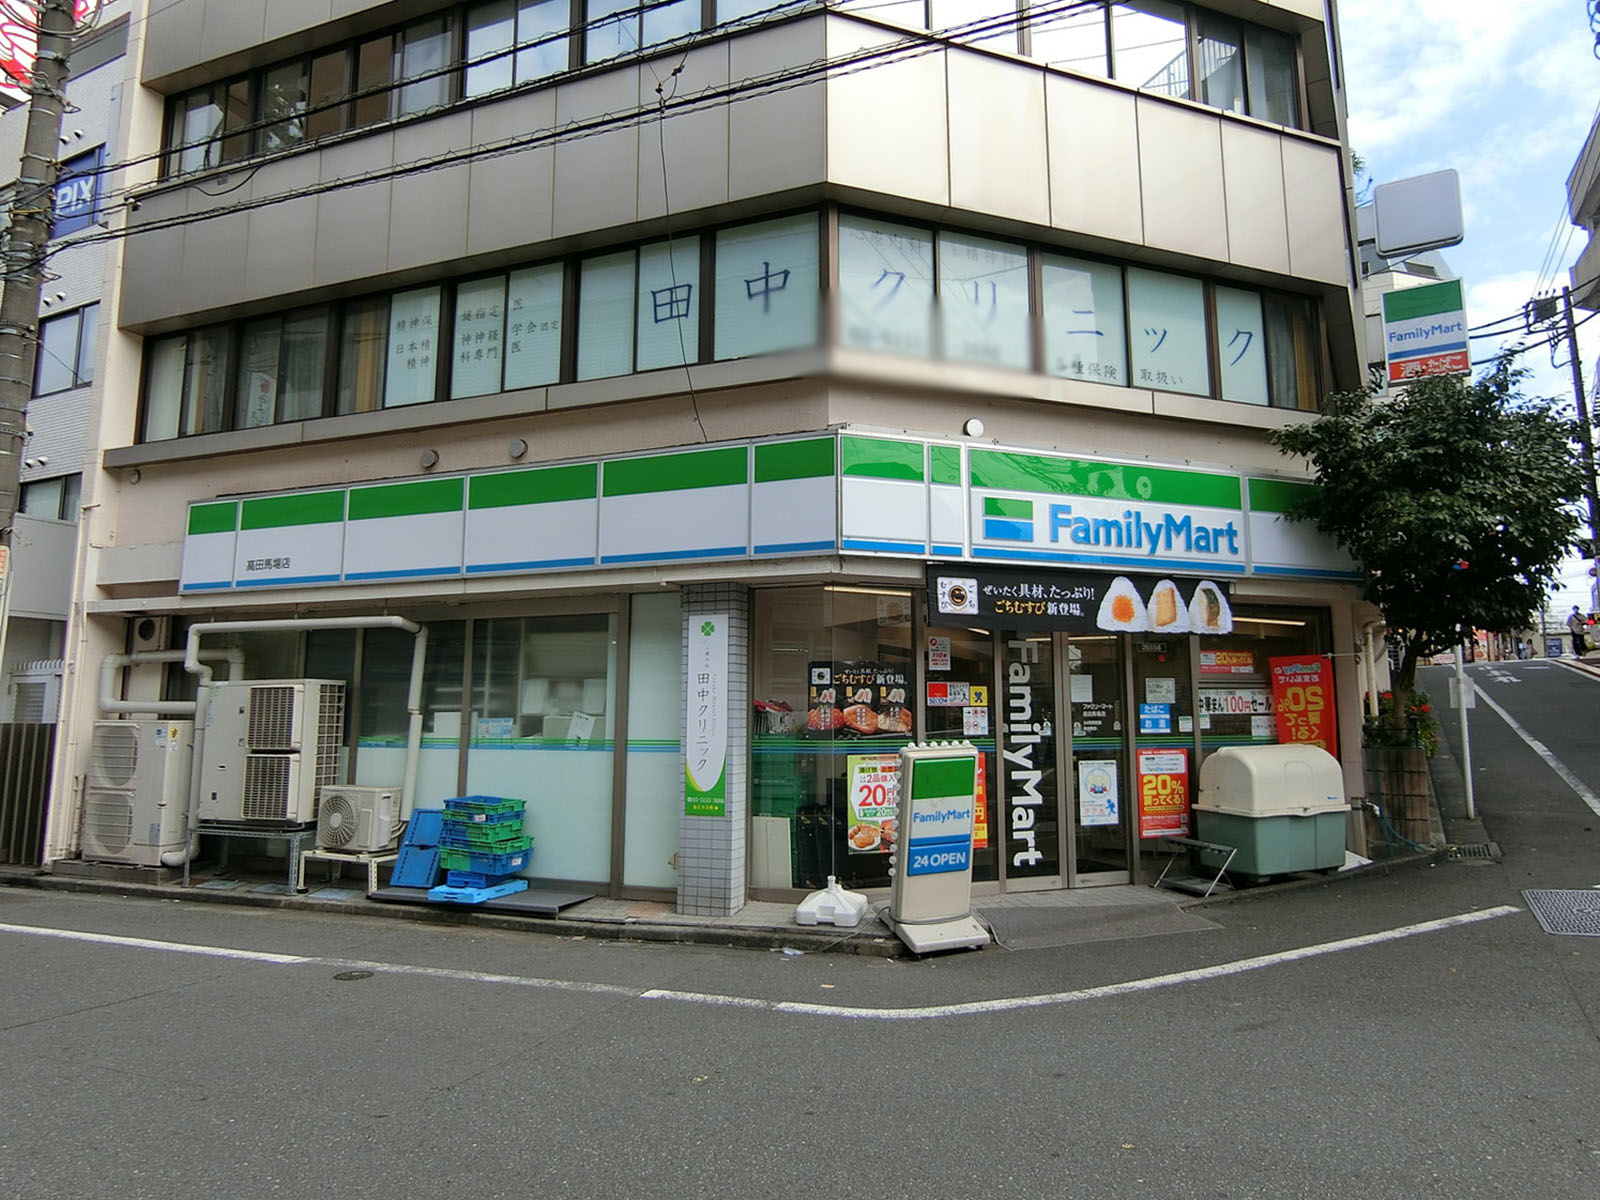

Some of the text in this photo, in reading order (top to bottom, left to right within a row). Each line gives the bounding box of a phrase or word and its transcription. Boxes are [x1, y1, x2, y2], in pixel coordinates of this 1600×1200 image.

[1389, 322, 1463, 342] FamilyMart
[1049, 503, 1239, 554] FamilyMart
[1002, 639, 1044, 867] FamilyMart
[913, 809, 970, 824] FamilyMart
[913, 852, 966, 868] 24 OPEN
